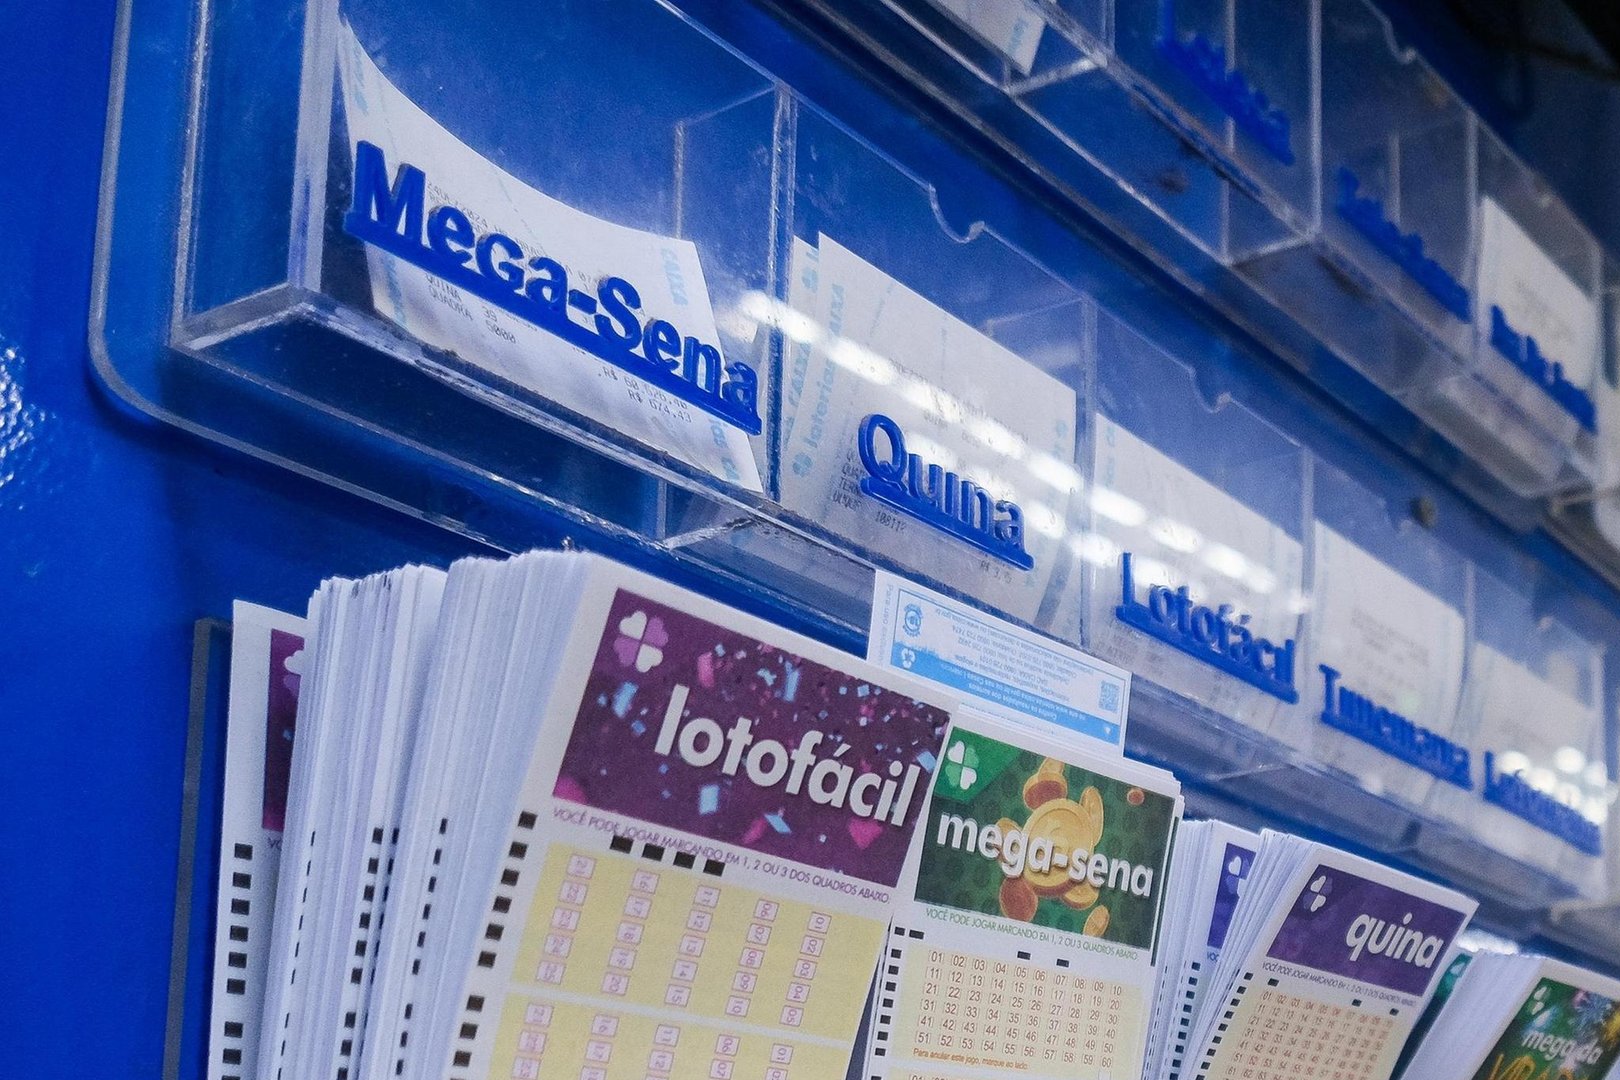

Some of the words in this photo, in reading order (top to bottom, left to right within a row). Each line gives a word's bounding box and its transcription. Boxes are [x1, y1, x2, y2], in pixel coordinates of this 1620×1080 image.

[858, 413, 1025, 548] Quina
[653, 684, 923, 827] lotofácil
[754, 860, 759, 870] 2
[763, 863, 779, 876] OU
[781, 867, 788, 877] 3
[789, 869, 810, 884] DOS
[812, 875, 857, 895] QUADROS
[936, 811, 1154, 897] mega-sena
[972, 917, 996, 930] JOGAR
[998, 924, 1038, 940] MARCANDO
[1346, 911, 1445, 970] quina
